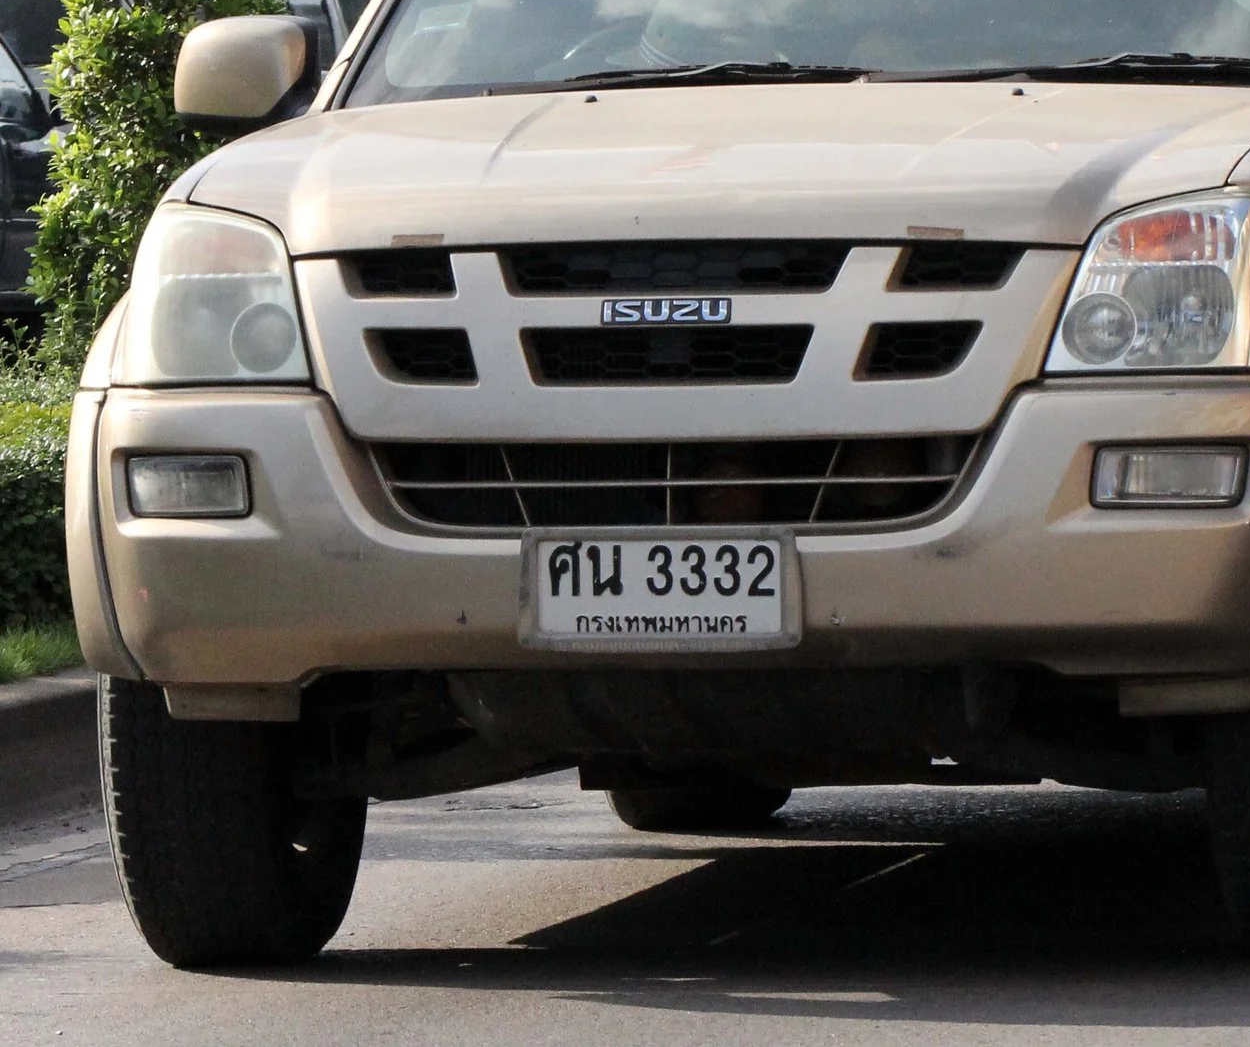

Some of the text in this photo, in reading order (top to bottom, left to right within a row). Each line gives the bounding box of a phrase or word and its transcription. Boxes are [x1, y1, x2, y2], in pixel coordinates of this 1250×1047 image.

[603, 300, 728, 323] ISUZU
[549, 541, 776, 597] ศน 3332
[576, 614, 748, 634] กรงเทพมหานคร
